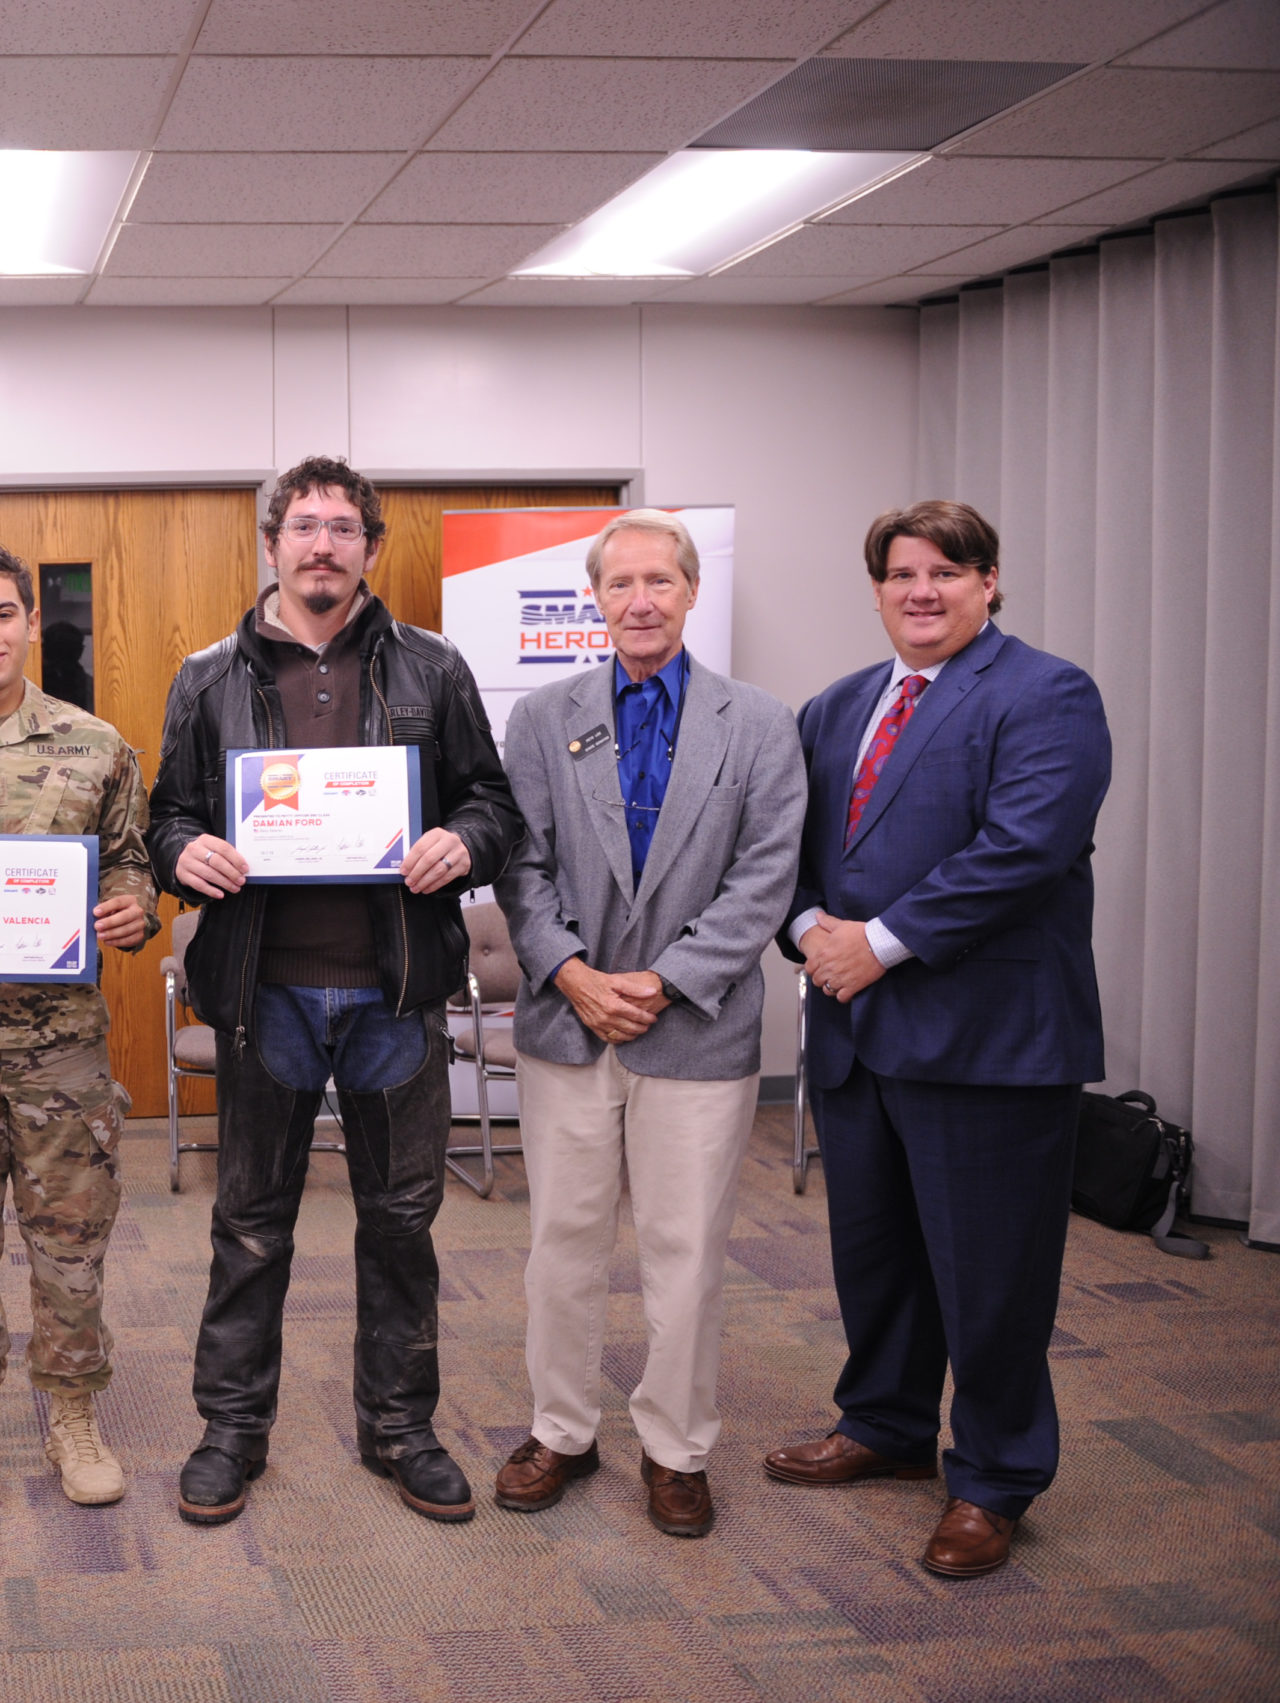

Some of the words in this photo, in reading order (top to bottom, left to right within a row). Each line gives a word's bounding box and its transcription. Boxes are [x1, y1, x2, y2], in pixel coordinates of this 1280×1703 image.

[520, 604, 607, 625] SMA
[520, 630, 616, 650] HERO
[58, 745, 91, 756] ARMY
[324, 771, 377, 781] CERTIFICATE
[253, 819, 293, 828] DAMIAN
[295, 818, 322, 827] FORD
[5, 868, 59, 878] CERTIFICATE
[3, 916, 51, 925] VALENCIA
